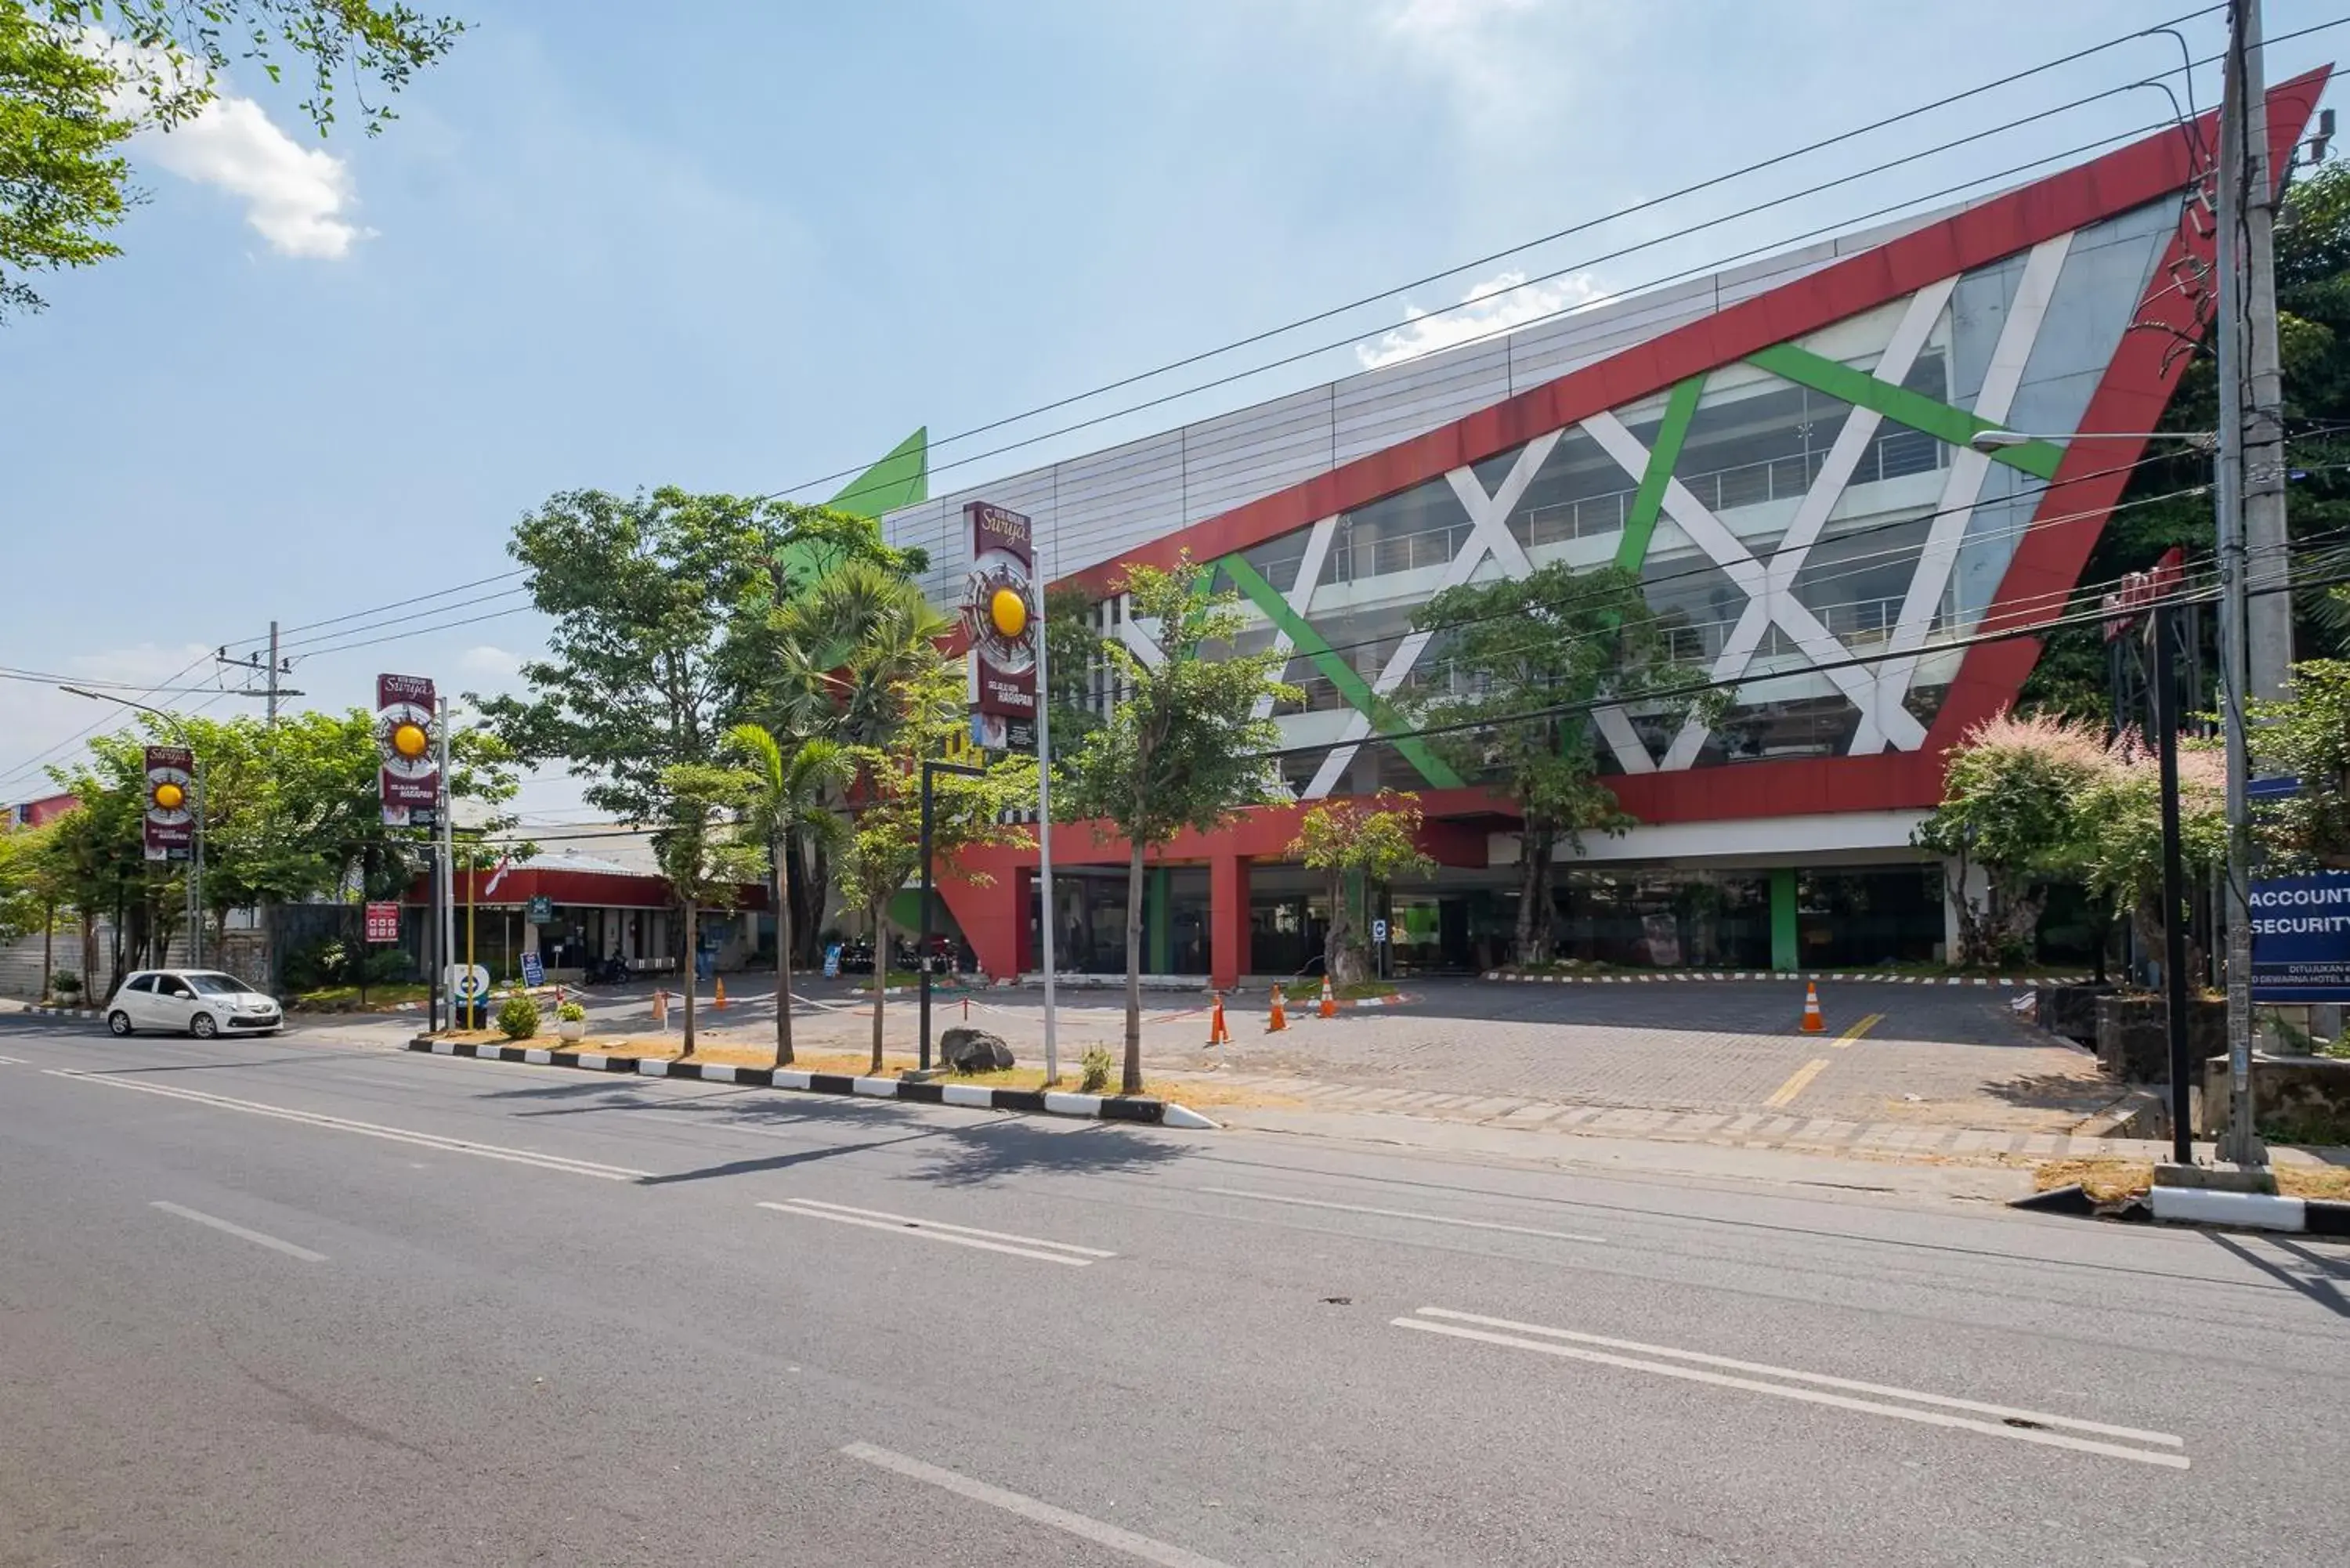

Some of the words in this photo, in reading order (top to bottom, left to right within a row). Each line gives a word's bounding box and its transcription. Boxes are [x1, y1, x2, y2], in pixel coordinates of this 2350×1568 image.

[982, 508, 1031, 546] Surya
[385, 676, 433, 699] Surya
[2310, 974, 2343, 984] HOTEL
